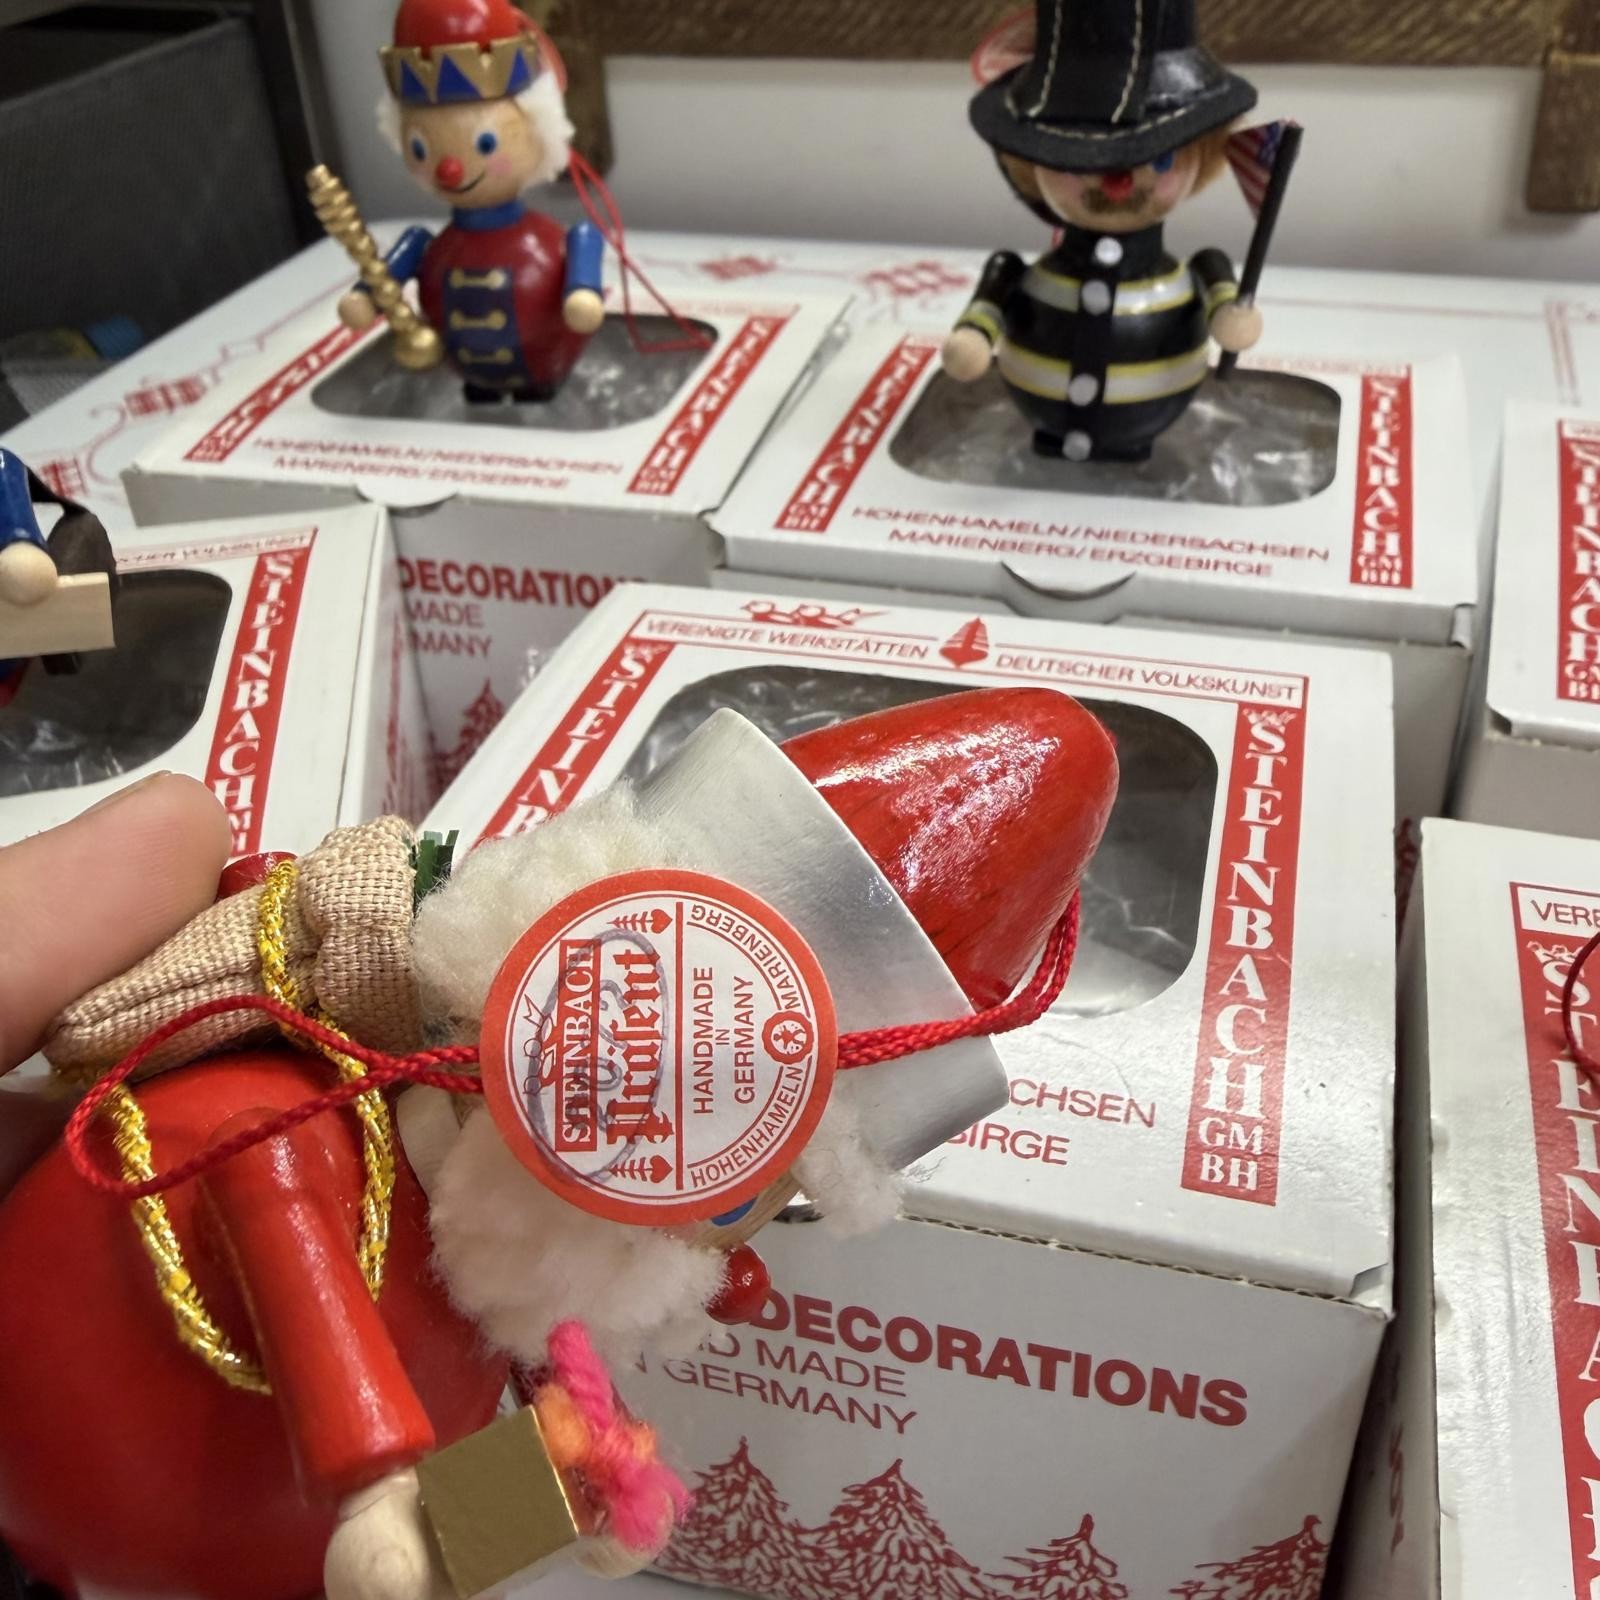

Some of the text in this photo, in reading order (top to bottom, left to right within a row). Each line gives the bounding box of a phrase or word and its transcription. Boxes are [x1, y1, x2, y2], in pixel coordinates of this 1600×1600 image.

[646, 619, 930, 660] VEREINIGTE WERKSTÄTTEN
[995, 653, 1299, 701] DEUTSCHER VOLKSKUNST
[691, 904, 801, 1009] MARIENBERG
[1202, 722, 1288, 1119] STEINBACH
[562, 944, 595, 1144] STEINBACH
[693, 966, 714, 1114] HANDMADE
[715, 1027, 730, 1046] IN
[733, 976, 755, 1104] GERMANY
[691, 1066, 804, 1188] HOHENHAMELN
[663, 1358, 917, 1434] GERMANY
[749, 1289, 1248, 1427] DECORATIONS
[756, 1339, 906, 1397] MADE
